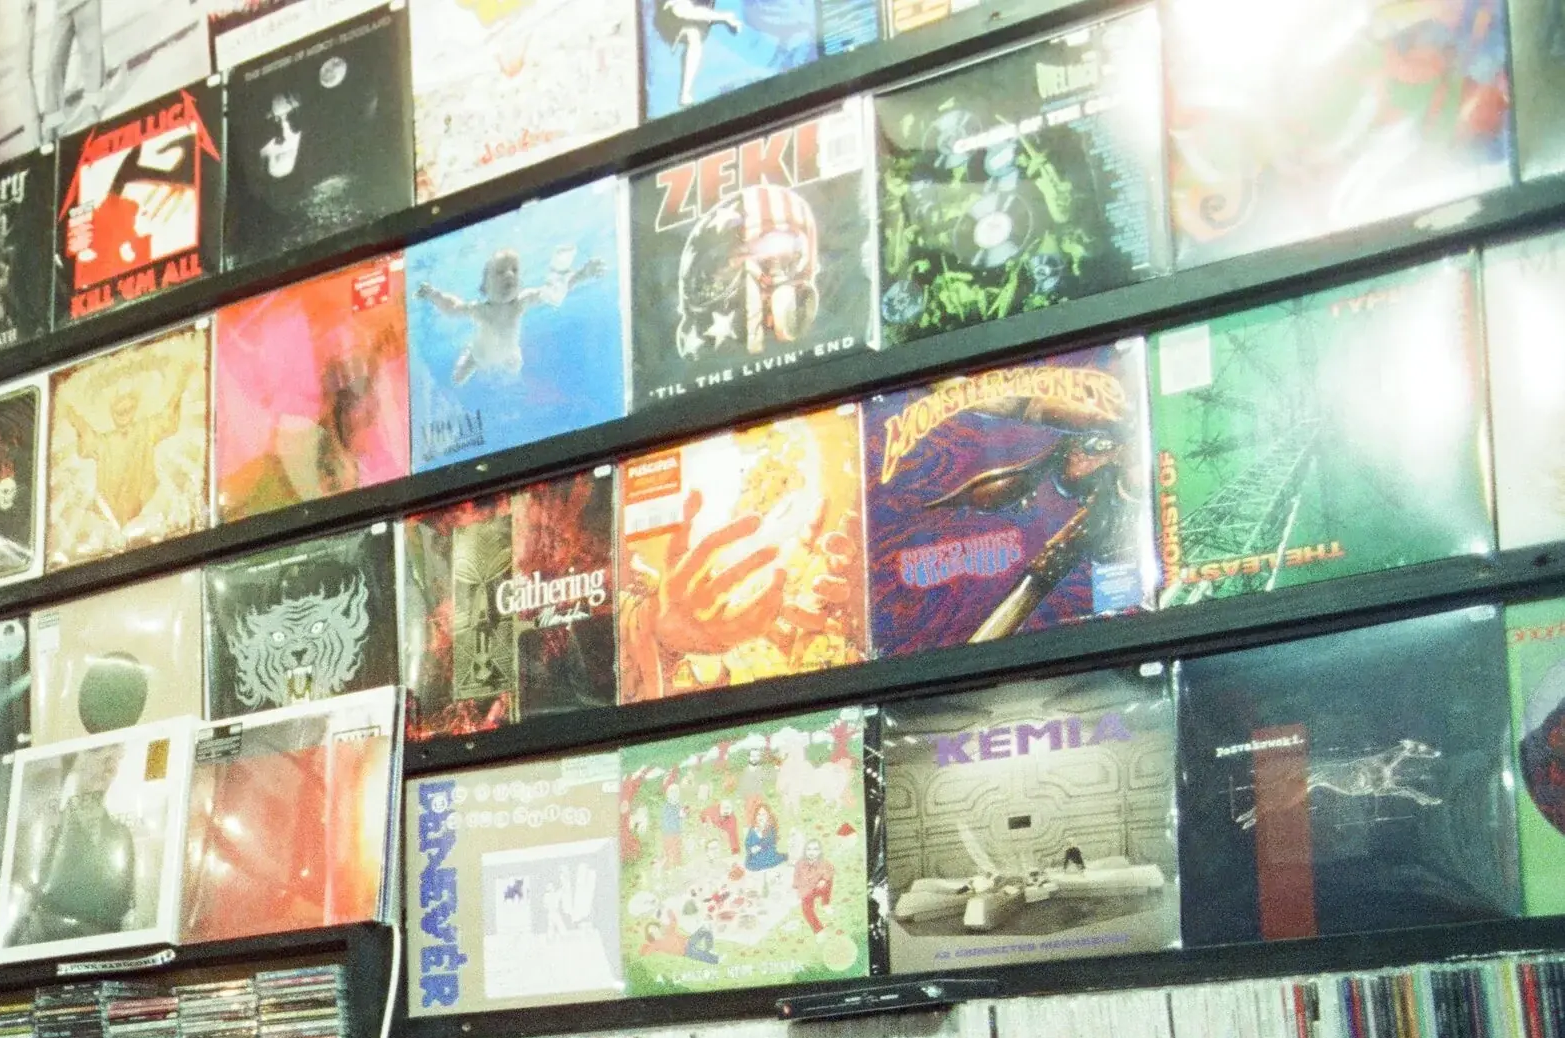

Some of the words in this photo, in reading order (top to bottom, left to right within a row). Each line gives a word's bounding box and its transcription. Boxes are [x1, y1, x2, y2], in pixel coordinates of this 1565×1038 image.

[71, 286, 115, 320] KILL
[162, 254, 203, 285] ALL
[649, 384, 688, 399] 'TIL
[696, 367, 734, 389] THE
[742, 350, 805, 377] LIVIN'
[815, 336, 855, 356] END
[1159, 451, 1178, 487] OF
[1183, 557, 1280, 585] LEAST
[1286, 540, 1346, 566] THE
[496, 567, 606, 618] Gathering
[934, 711, 1134, 769] KEMIA
